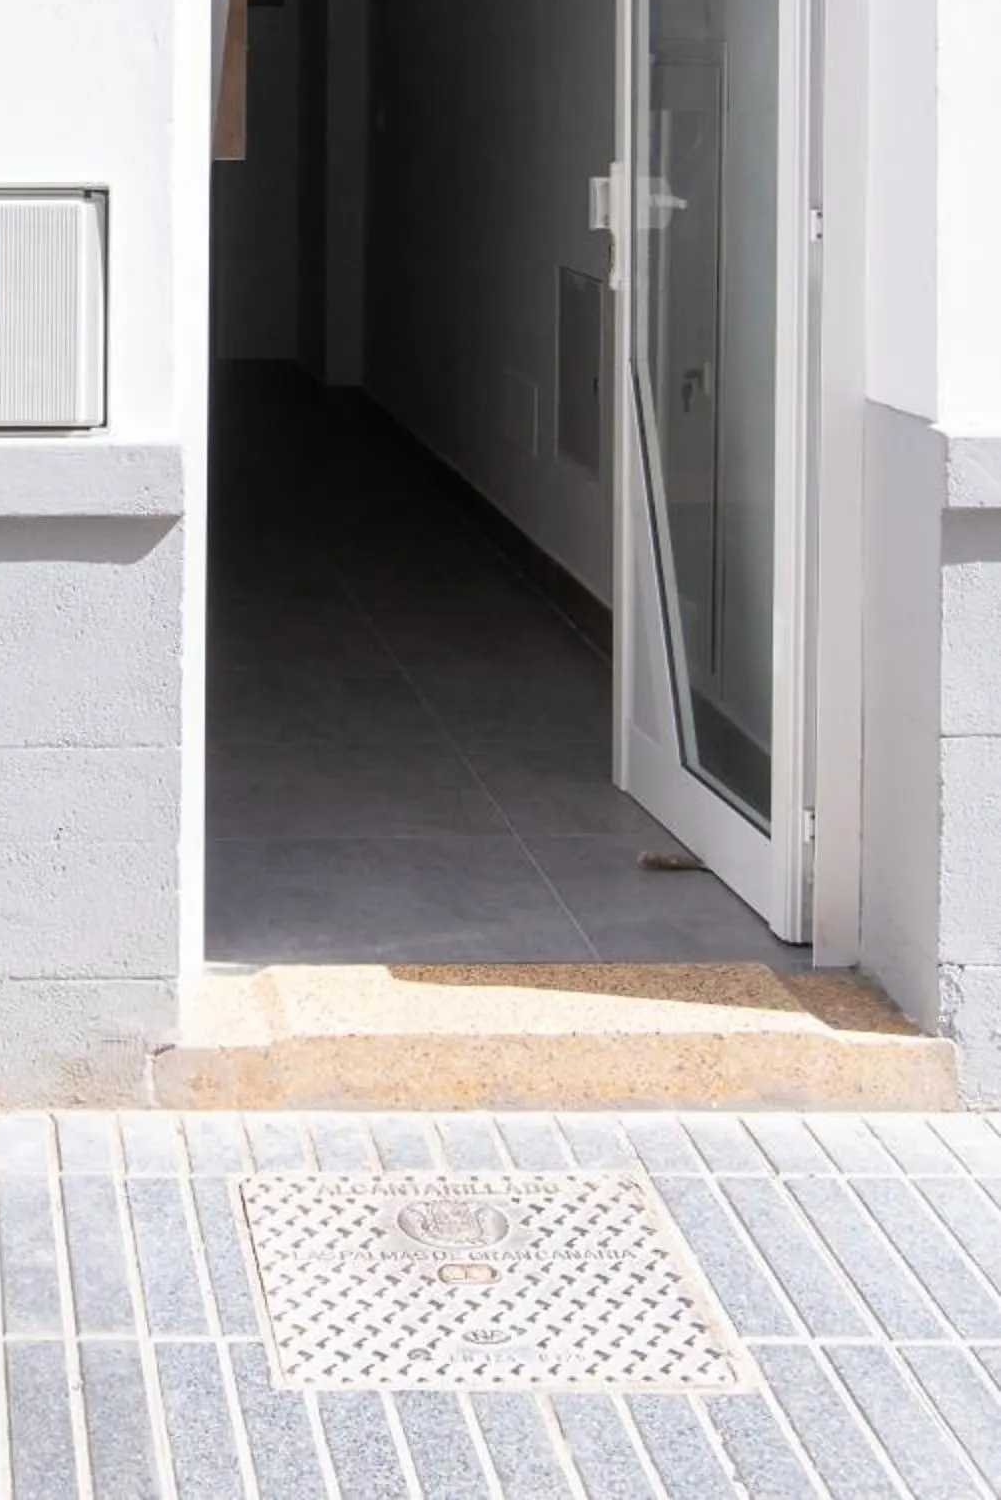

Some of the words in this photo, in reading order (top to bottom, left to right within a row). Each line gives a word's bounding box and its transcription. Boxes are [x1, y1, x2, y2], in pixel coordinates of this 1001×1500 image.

[316, 1182, 561, 1196] ALCANTARILLADO
[291, 1250, 331, 1261] LAS
[339, 1250, 429, 1261] PALMAS
[432, 1250, 465, 1261] DE
[468, 1250, 532, 1261] GRAN
[534, 1250, 638, 1261] CANARIA
